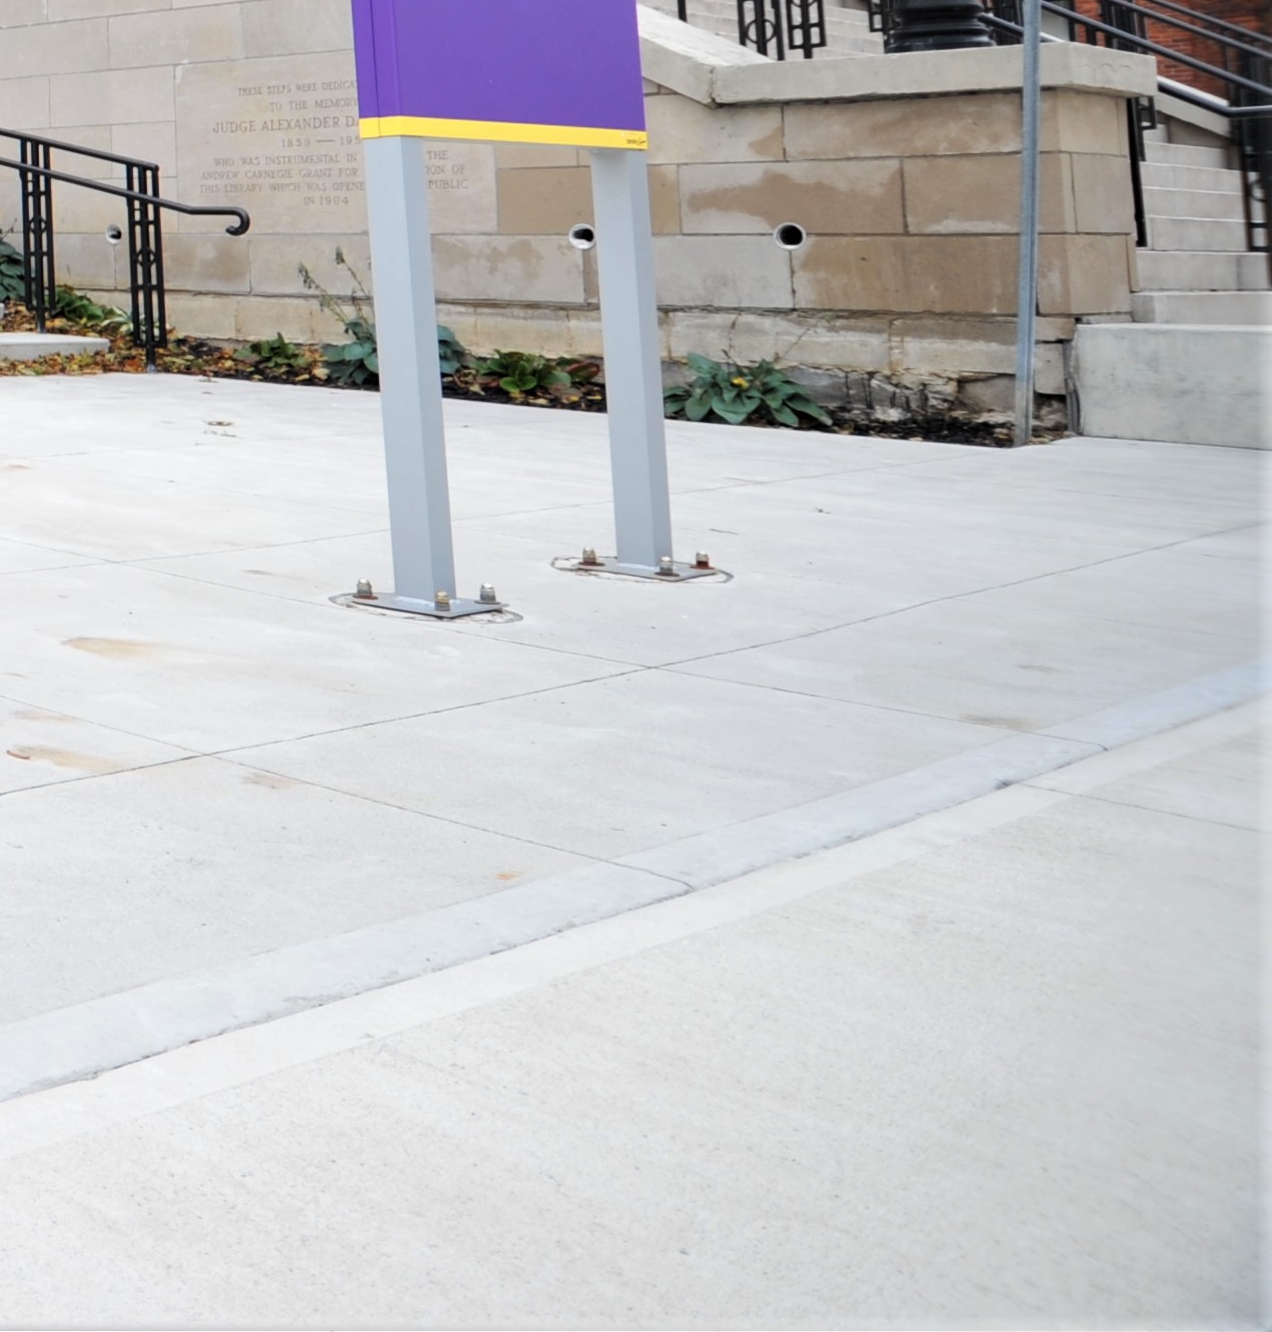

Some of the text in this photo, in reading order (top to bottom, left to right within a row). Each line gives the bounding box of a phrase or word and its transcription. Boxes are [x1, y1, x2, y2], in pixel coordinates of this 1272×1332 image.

[237, 79, 356, 97] THESE STEPS WERE DEDICA
[269, 100, 283, 112] TO
[288, 99, 308, 111] THE
[212, 119, 257, 134] JUDGE
[260, 115, 341, 132] ALEXANDER
[213, 149, 450, 167] WHO WAS INSTRUMENTAL IN THE
[200, 170, 240, 181] ANDREW
[244, 168, 294, 180] CARNEGIE
[298, 167, 333, 179] GRANT
[338, 167, 359, 178] FOR
[451, 163, 466, 175] OF
[199, 178, 469, 194] THIS LIBRARY WHICH WAS OPENE PUBLIC
[319, 195, 350, 207] 1904
